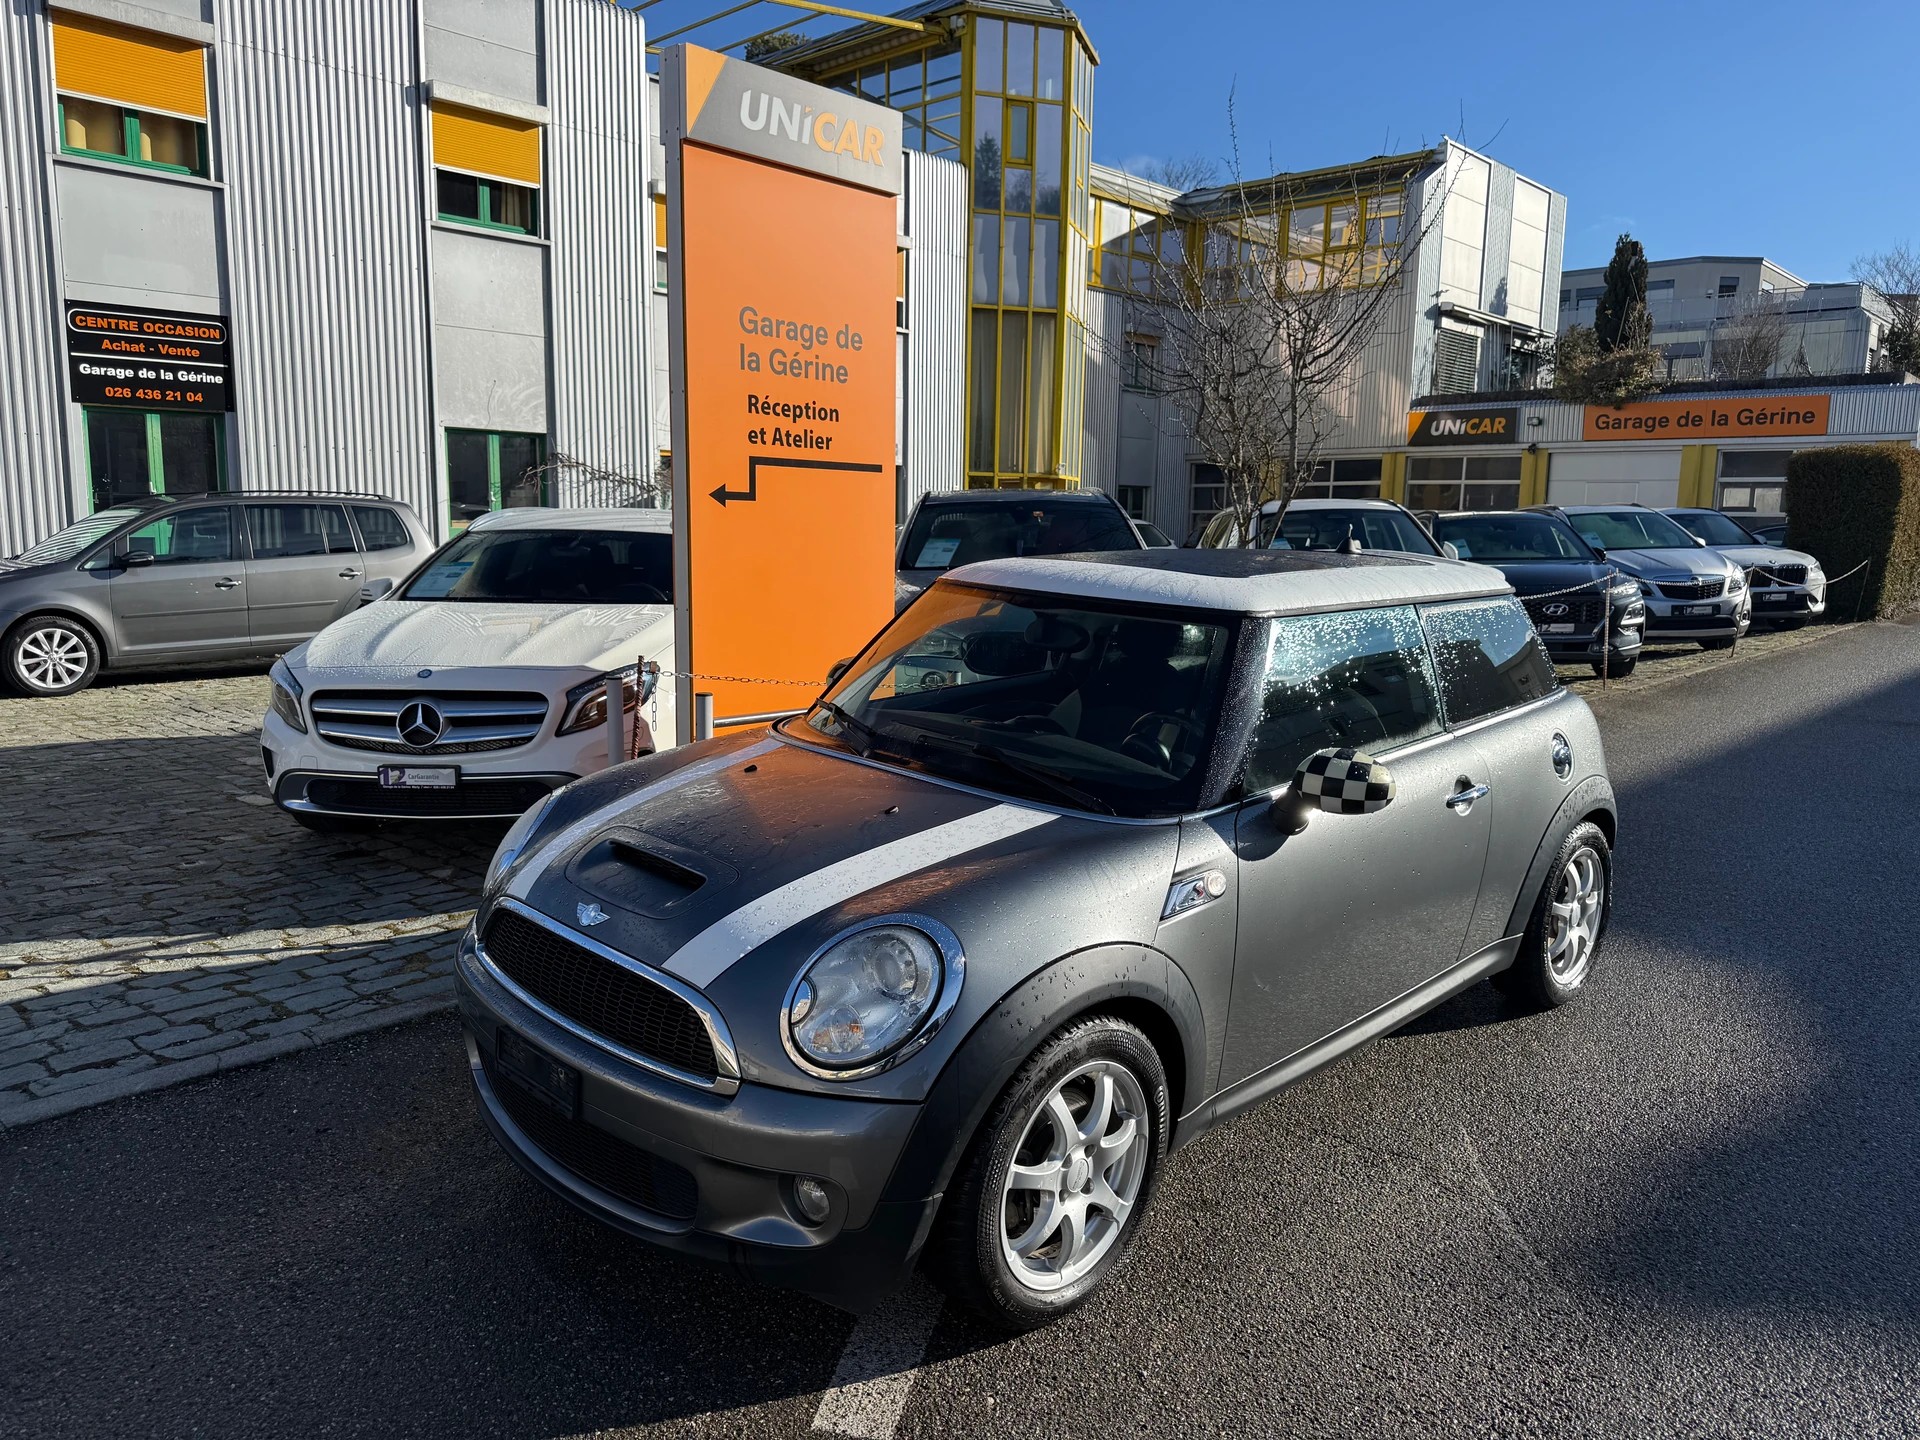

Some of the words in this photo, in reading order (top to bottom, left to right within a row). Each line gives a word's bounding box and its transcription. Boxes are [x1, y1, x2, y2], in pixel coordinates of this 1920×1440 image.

[75, 315, 139, 332] CENTRE
[143, 322, 220, 339] OCCASION
[739, 306, 828, 350] Garage
[836, 324, 863, 351] de
[101, 339, 145, 353] Achat
[158, 343, 200, 358] Vente
[79, 363, 134, 380] Garage
[138, 368, 156, 380] de
[160, 370, 174, 381] la
[177, 370, 224, 384] Gérine
[740, 343, 761, 372] la
[769, 348, 848, 384] Gérine
[105, 386, 132, 398] 026
[135, 388, 162, 400] 436
[165, 390, 181, 401] 21
[186, 392, 203, 403] 04
[747, 394, 840, 423] Réception
[1595, 413, 1670, 433] Garage
[1676, 410, 1703, 428] de
[1710, 410, 1729, 427] la
[1736, 407, 1816, 426] Gérine
[747, 427, 767, 446] et
[772, 427, 833, 450] Atelier
